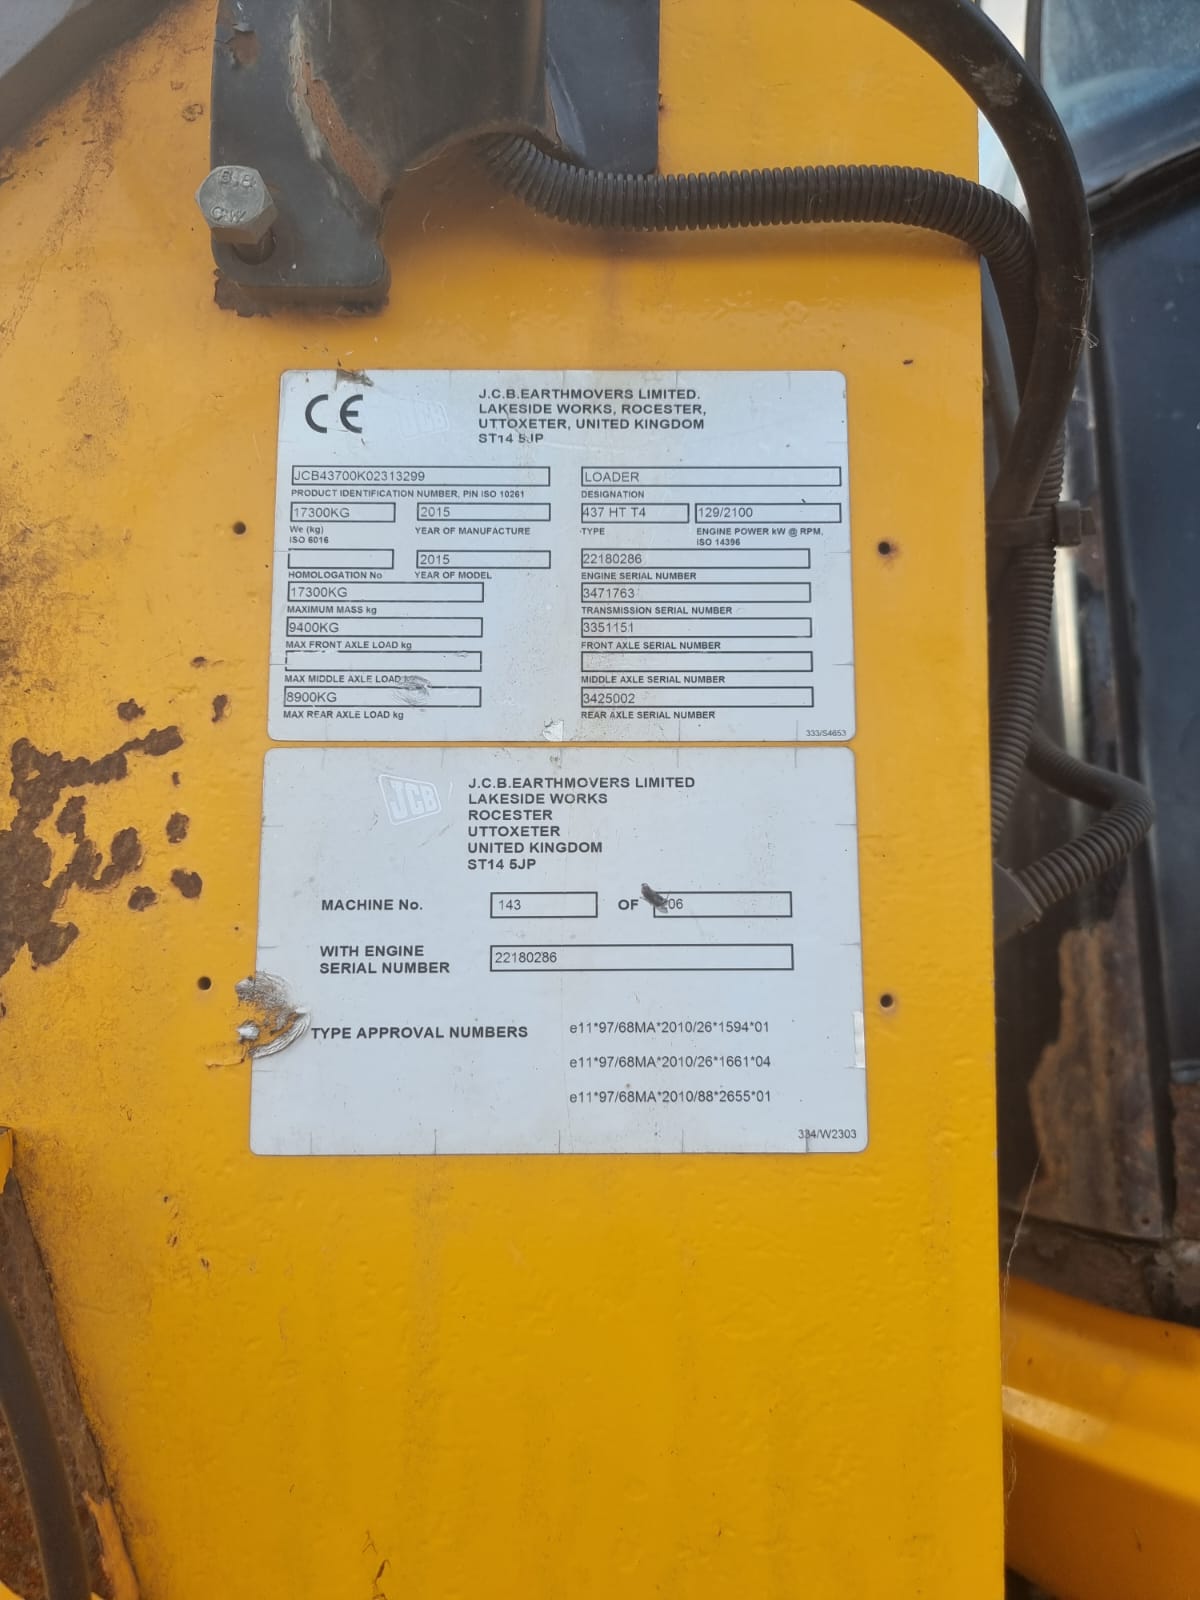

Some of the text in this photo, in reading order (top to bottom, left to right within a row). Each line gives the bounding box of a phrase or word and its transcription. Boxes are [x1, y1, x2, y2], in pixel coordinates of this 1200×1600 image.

[478, 388, 701, 399] J.C.B.EARTHMOVERS LIMITED.
[305, 394, 364, 434] CE
[479, 403, 707, 417] LAKESIDE WORKS, ROCESTER,
[478, 418, 705, 431] UTTOXETER, UNITED KINGDOM
[478, 432, 544, 444] ST14 5JP
[293, 470, 426, 482] JCB43700K02313299
[584, 471, 640, 483] LOADER
[291, 489, 337, 498] PRODUCT
[340, 489, 414, 498] IDENTIFICATION
[462, 489, 478, 498] PIN
[481, 489, 497, 498] ISO
[500, 489, 525, 498] 10261
[581, 490, 645, 499] DESIGNATION
[294, 506, 351, 518] 17300KG
[420, 506, 451, 518] 2015
[582, 507, 647, 519] 437 HT T4
[698, 507, 753, 519] 129/2100
[289, 525, 324, 536] We (kg)
[415, 527, 531, 536] YEAR OF MANUFACTURE
[581, 527, 606, 536] TYPE
[696, 527, 732, 536] ENGINE
[734, 527, 770, 536] POWER
[771, 527, 786, 536] kW
[289, 536, 329, 545] ISO 6016
[696, 538, 741, 547] ISO 14396
[419, 554, 450, 566] 2015
[582, 553, 643, 565] 22180286
[288, 571, 383, 579] HOMOLOGATION No
[414, 571, 493, 580] YEAR OF MODEL
[581, 571, 697, 581] ENGINE SERIAL NUMBER
[291, 586, 348, 598] 17300KG
[583, 587, 635, 599] 3471763
[287, 605, 378, 616] MAXIMUM MASS kg
[581, 606, 733, 615] TRANSMISSION SERIAL NUMBER
[288, 622, 340, 634] 9400KG
[583, 622, 634, 634] 3351151
[285, 640, 413, 651] MAX FRONT AXLE LOAD kg
[581, 641, 721, 650] FRONT AXLE SERIAL NUMBER
[284, 675, 306, 683] MAX
[308, 675, 345, 683] MIDDLE
[347, 675, 373, 683] AXLE
[375, 675, 402, 683] LOAD
[581, 675, 726, 684] MIDDLE AXLE SERIAL NUMBER
[286, 691, 338, 703] 8900KG
[583, 693, 635, 705] 3425002
[283, 710, 405, 721] MAX REAR AXLE LOAD kg
[581, 710, 716, 720] REAR AXLE SERIAL NUMBER
[468, 777, 695, 789] J.C.B.EARTHMOVERS LIMITED
[387, 779, 438, 820] JCB
[468, 793, 608, 805] LAKESIDE WORKS
[468, 809, 553, 821] ROCESTER
[468, 825, 561, 837] UTTOXETER
[467, 842, 603, 854] UNITED KINGDOM
[467, 858, 537, 870] ST14 5JP
[321, 899, 423, 911] MACHINE No.
[498, 899, 522, 911] 143
[617, 899, 639, 910] OF
[320, 945, 425, 957] WITH ENGINE
[494, 951, 558, 963] 22180286
[319, 961, 450, 974] SERIAL NUMBER
[311, 1026, 529, 1039] TYPE APPROVAL NUMBERS
[797, 1128, 857, 1140] 334/W2303
